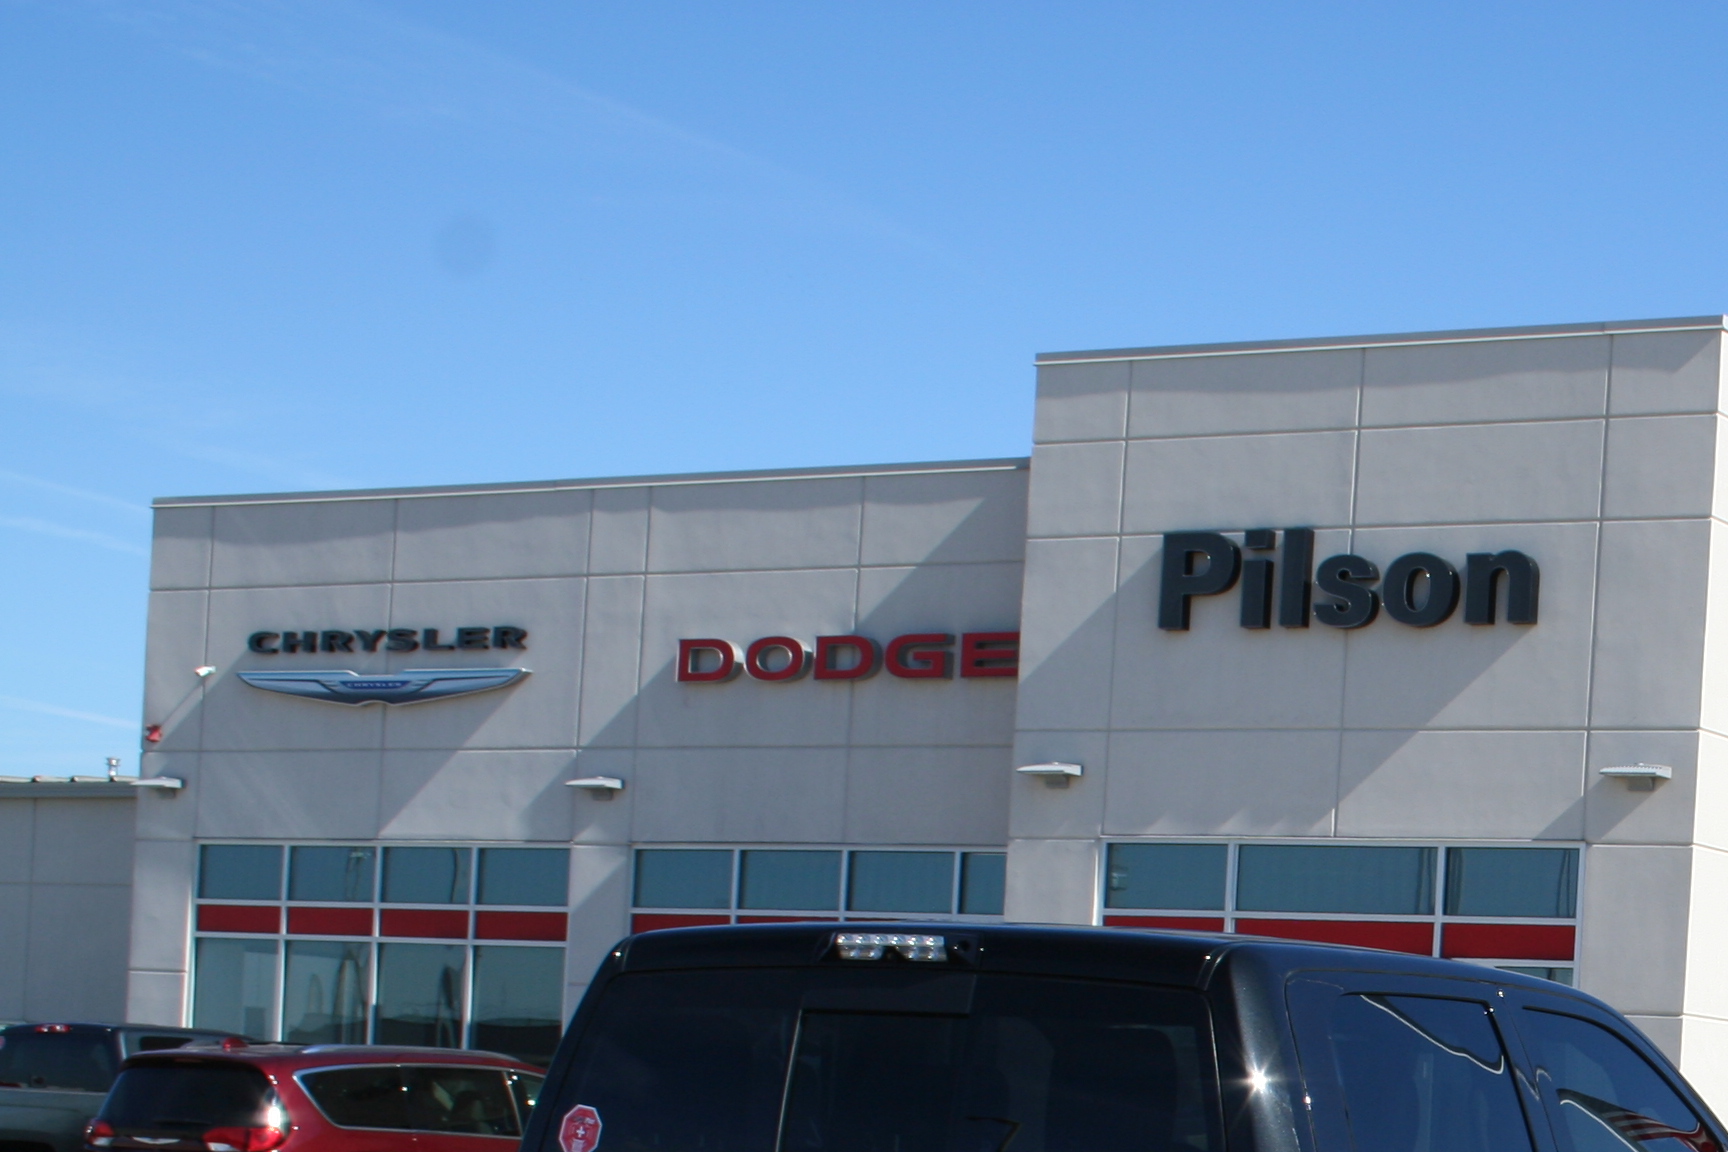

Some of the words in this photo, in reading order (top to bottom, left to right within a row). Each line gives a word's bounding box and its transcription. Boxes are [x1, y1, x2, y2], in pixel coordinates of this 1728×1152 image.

[1158, 527, 1540, 630] Pilson
[248, 626, 528, 654] CHRYSLER
[676, 631, 1020, 683] DODGE
